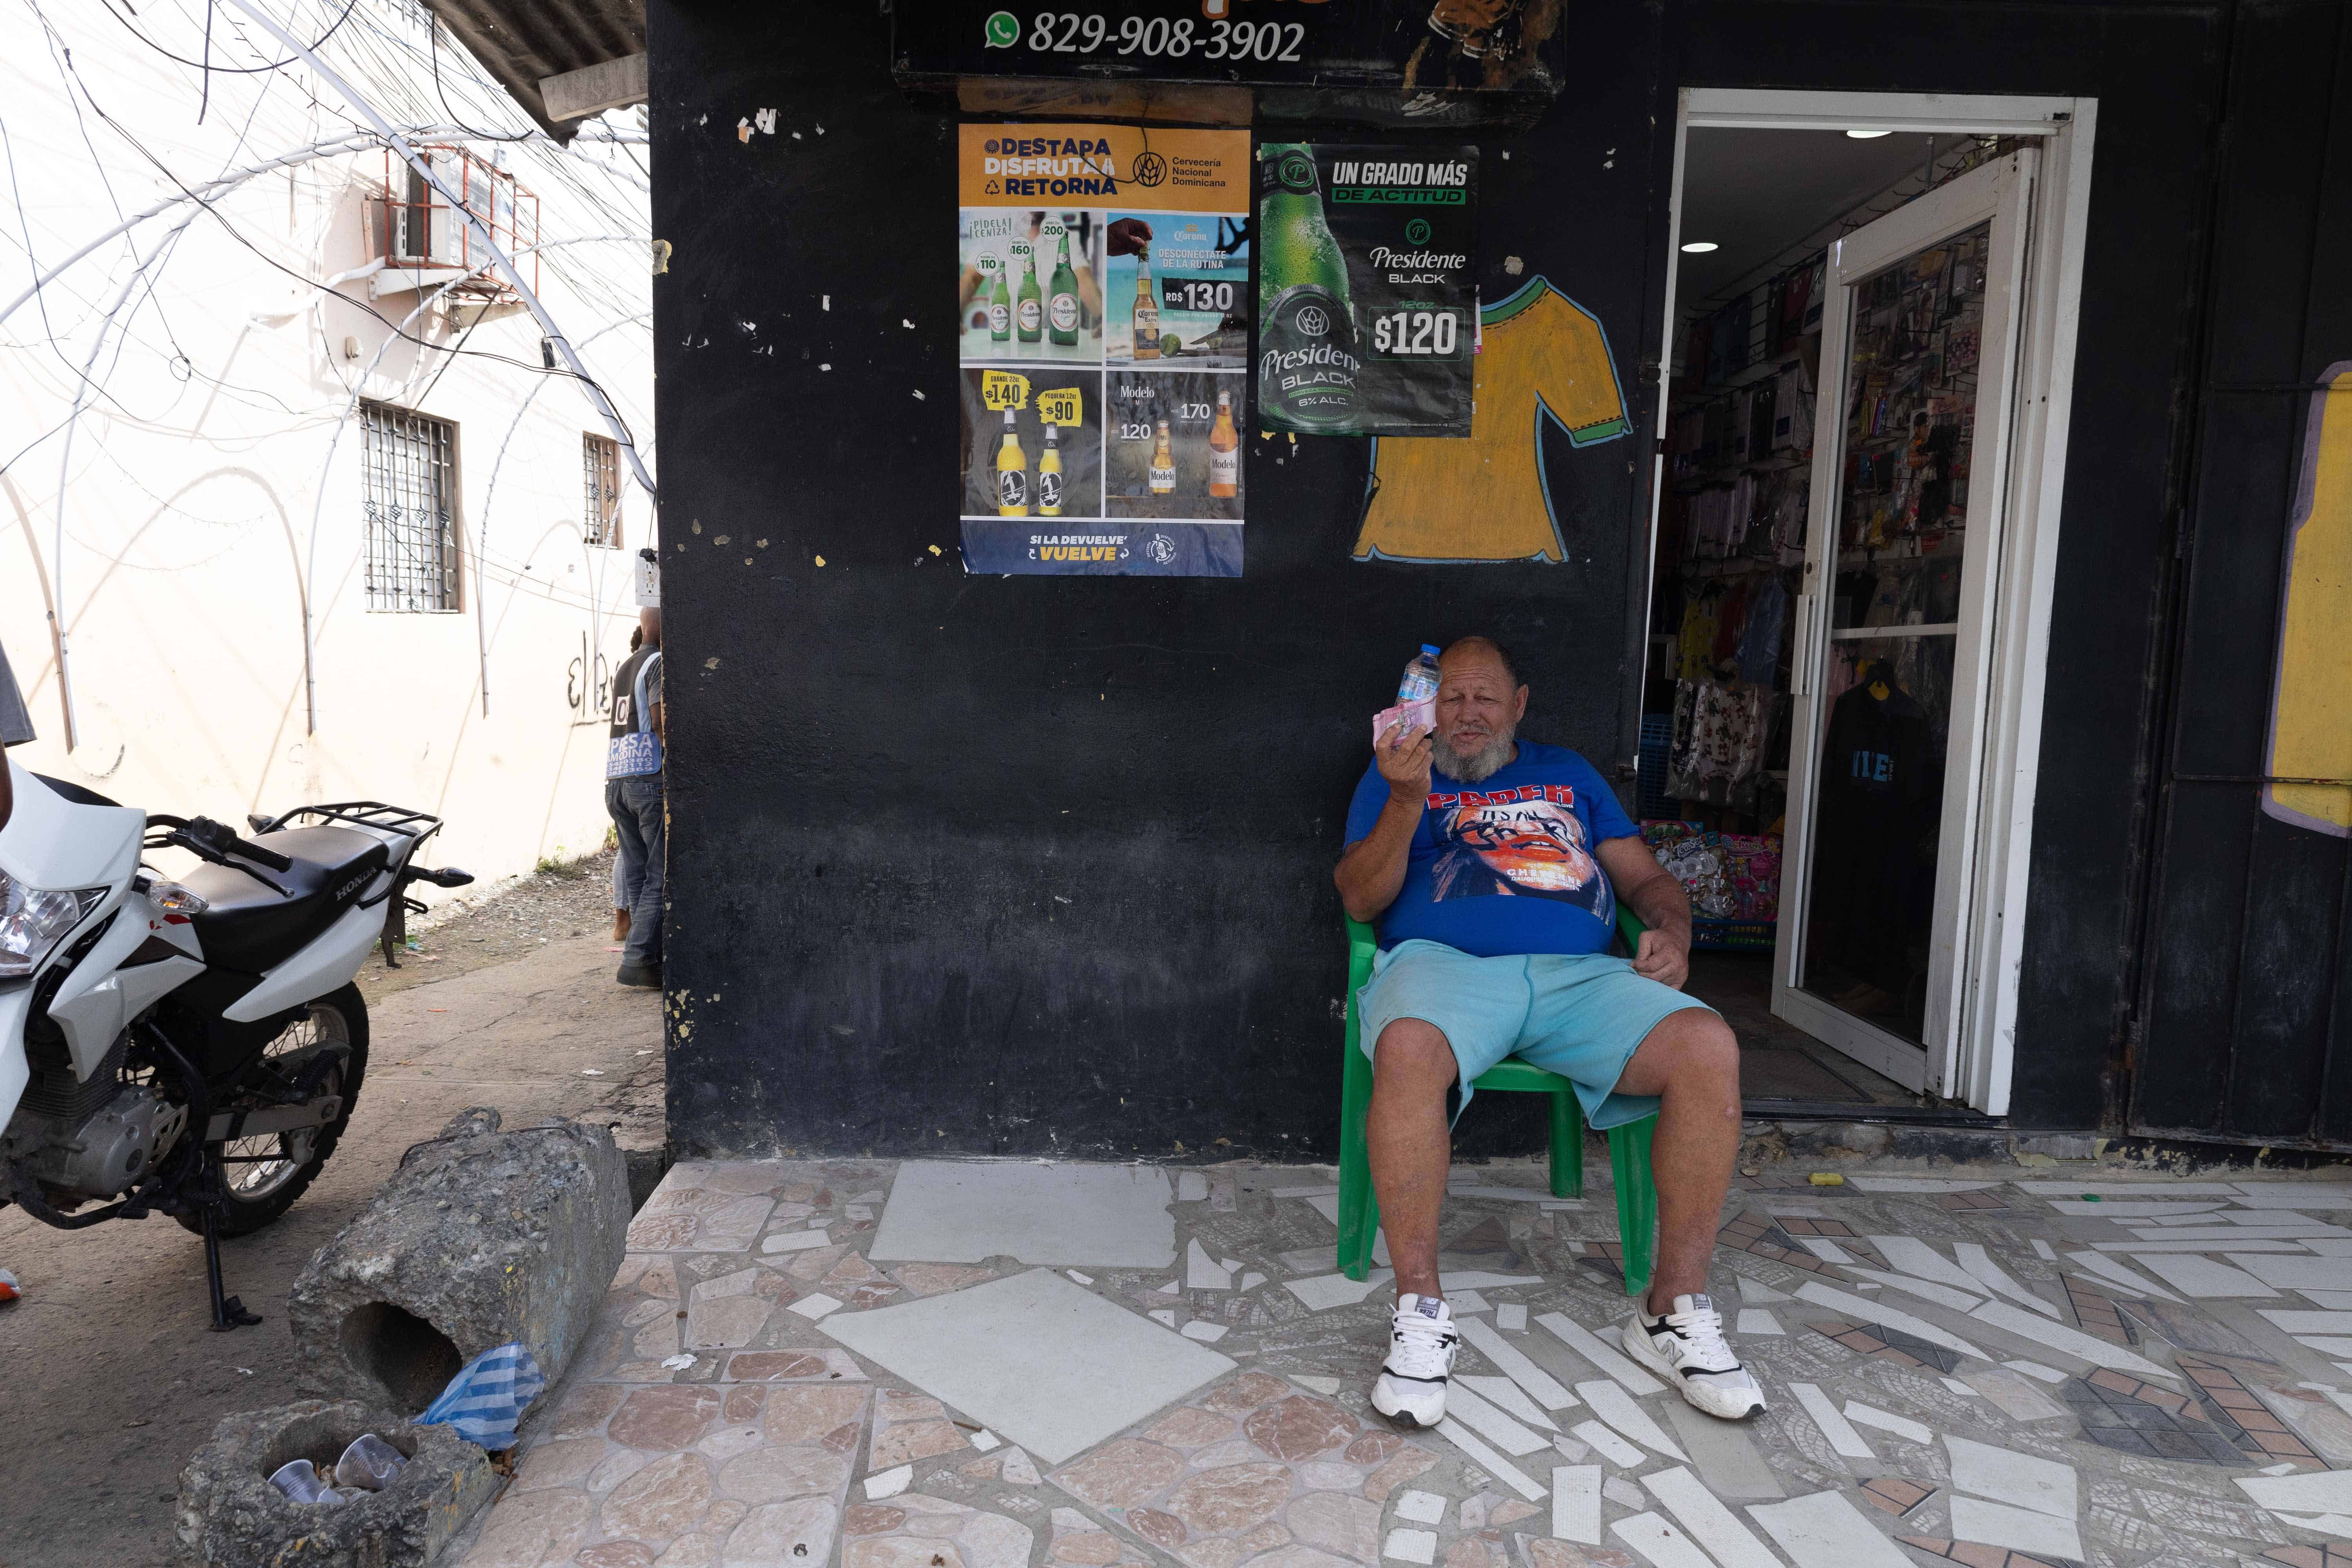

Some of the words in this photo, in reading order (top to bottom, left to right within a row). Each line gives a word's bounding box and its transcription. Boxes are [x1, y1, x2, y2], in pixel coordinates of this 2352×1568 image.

[1029, 12, 1305, 61] 829-908-3902
[1002, 138, 1111, 156] DESTAPA
[985, 157, 1100, 176] DISFRUTA
[1172, 157, 1221, 167] Cervecería
[1172, 167, 1211, 176] Nacional
[1333, 162, 1359, 184] UN
[1361, 163, 1424, 185] GRADO
[1426, 160, 1468, 186] MÁS
[1005, 178, 1118, 196] RETORNA
[1172, 177, 1226, 187] Dominicana
[1335, 189, 1365, 201] DE
[1367, 189, 1462, 202] ACTITUD
[1174, 230, 1209, 242] Corona
[1158, 247, 1226, 260] DESCONÉCTATE
[1369, 247, 1466, 269] Presidente
[1163, 258, 1174, 268] DE
[1176, 259, 1188, 268] LA
[1191, 259, 1224, 269] RUTINA
[1388, 274, 1446, 284] BLACK
[1183, 283, 1233, 310] 130
[1375, 312, 1457, 354] $120
[1281, 371, 1356, 391] BLACK
[985, 384, 1020, 403] $140
[1120, 385, 1155, 398] Modelo
[1298, 396, 1317, 407] 6%
[1319, 396, 1348, 406] ALC.
[1046, 401, 1073, 421] $90
[1181, 403, 1210, 419] 170
[1121, 423, 1151, 439] 120
[1212, 459, 1236, 469] Modelo
[1151, 470, 1174, 481] Modelo
[1029, 535, 1042, 544] SI
[1043, 535, 1059, 544] LA
[1160, 534, 1176, 546] DISFRUTA
[1040, 546, 1117, 561] VUELVE
[336, 865, 378, 901] HONDA
[1419, 1308, 1434, 1316] 997H
